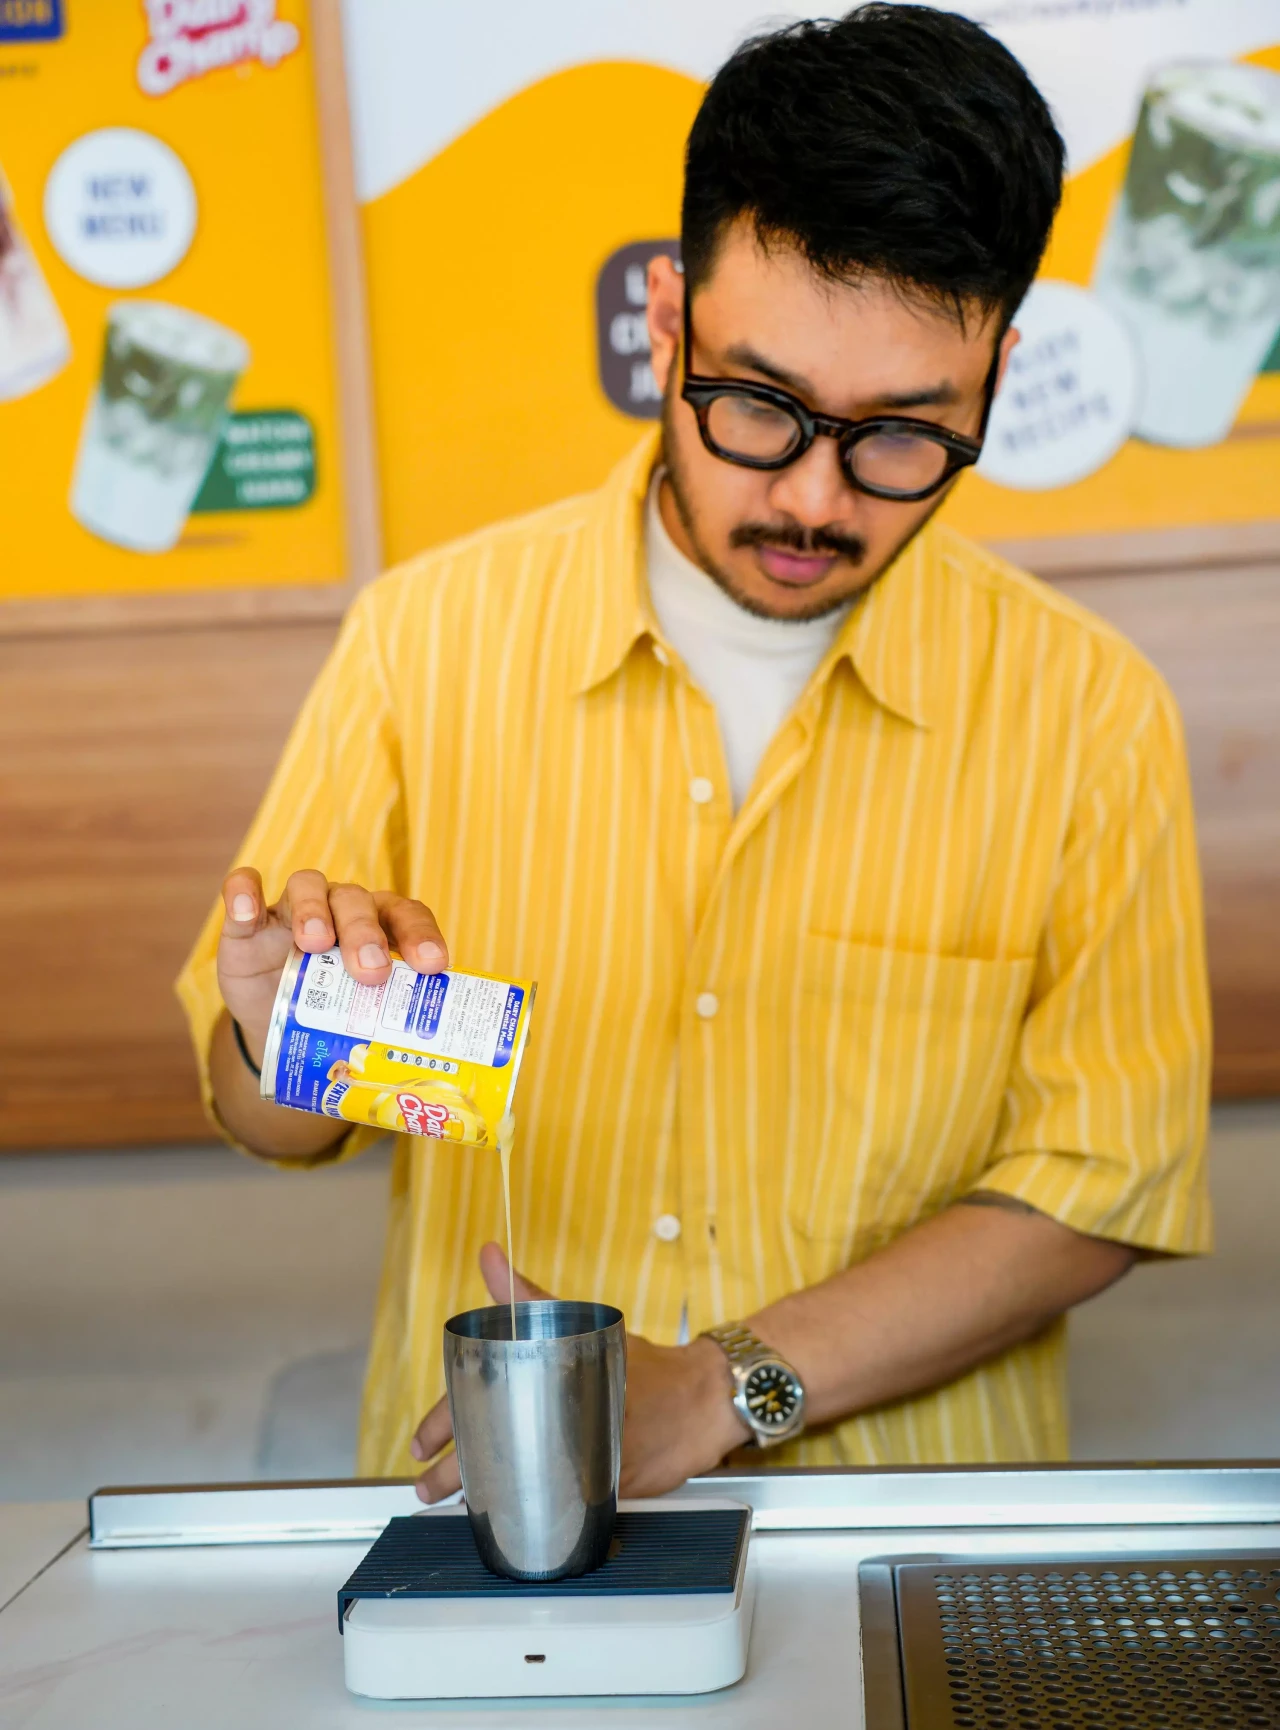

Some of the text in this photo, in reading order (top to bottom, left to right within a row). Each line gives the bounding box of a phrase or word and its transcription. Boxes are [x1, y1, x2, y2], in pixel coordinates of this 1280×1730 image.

[502, 1009, 511, 1030] Kental
[507, 1000, 520, 1042] DAIRY CHAMP
[312, 1040, 330, 1067] etika
[497, 1030, 507, 1052] Manis
[400, 1095, 424, 1135] Cham
